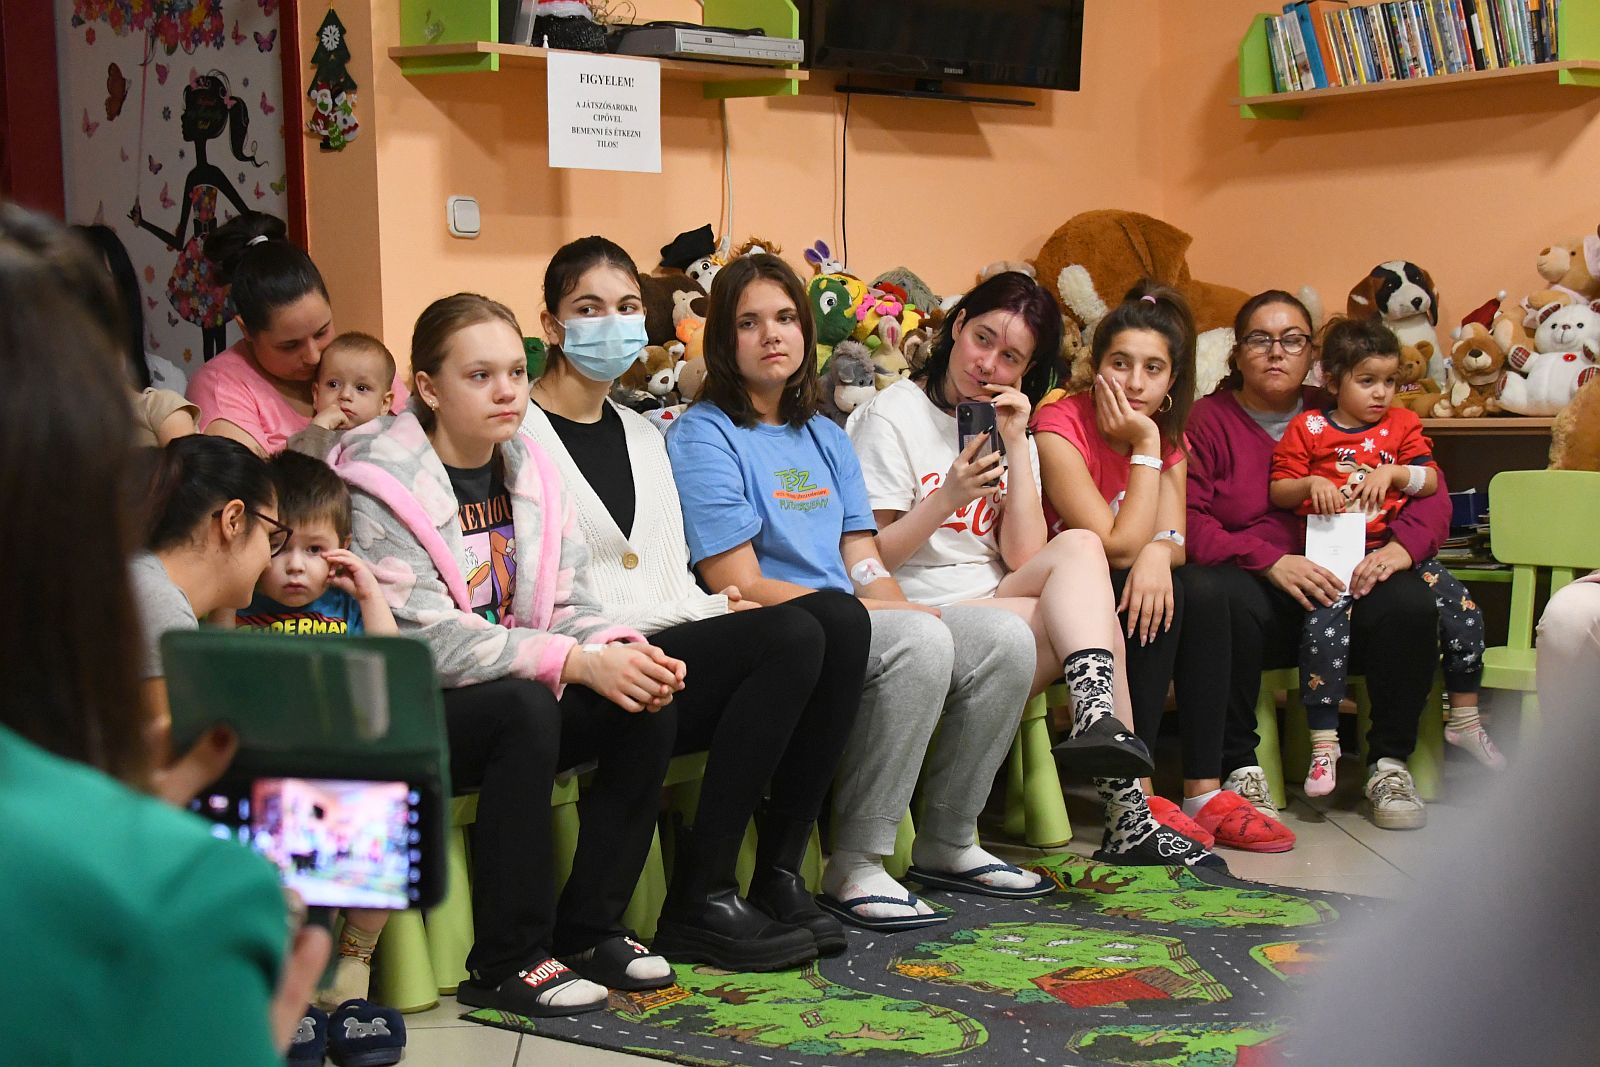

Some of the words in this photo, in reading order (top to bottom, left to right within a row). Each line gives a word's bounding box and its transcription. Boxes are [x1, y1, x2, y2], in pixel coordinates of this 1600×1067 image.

[580, 73, 635, 87] FIGYELEM!
[582, 99, 638, 112] JÁTSZÓSAROKBA
[571, 126, 603, 136] BEMENNI
[604, 127, 613, 136] ÉS
[614, 127, 641, 138] ÉTKEZNI
[597, 140, 619, 149] TILOS!
